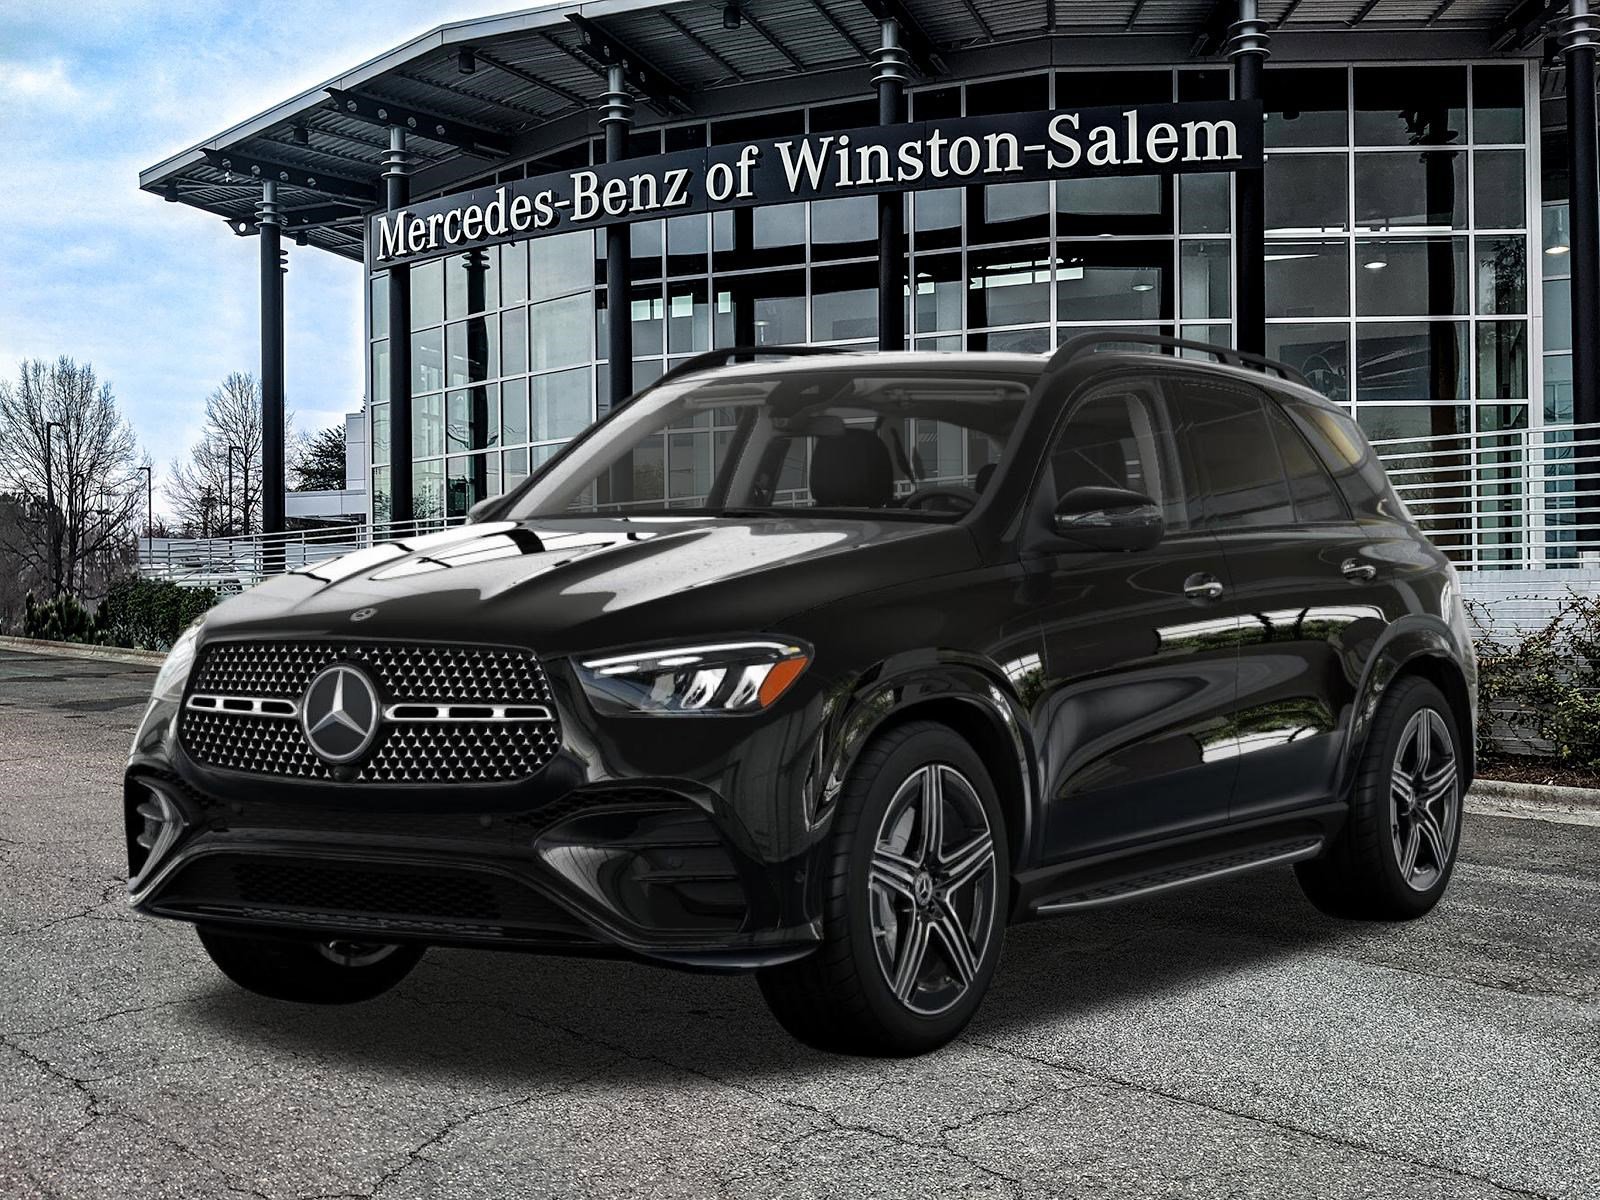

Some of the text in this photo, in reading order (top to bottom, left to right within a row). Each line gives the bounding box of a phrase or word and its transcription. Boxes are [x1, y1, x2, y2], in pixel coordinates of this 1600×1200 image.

[376, 109, 1243, 262] Mercedes-Benz of Winston-Salem
